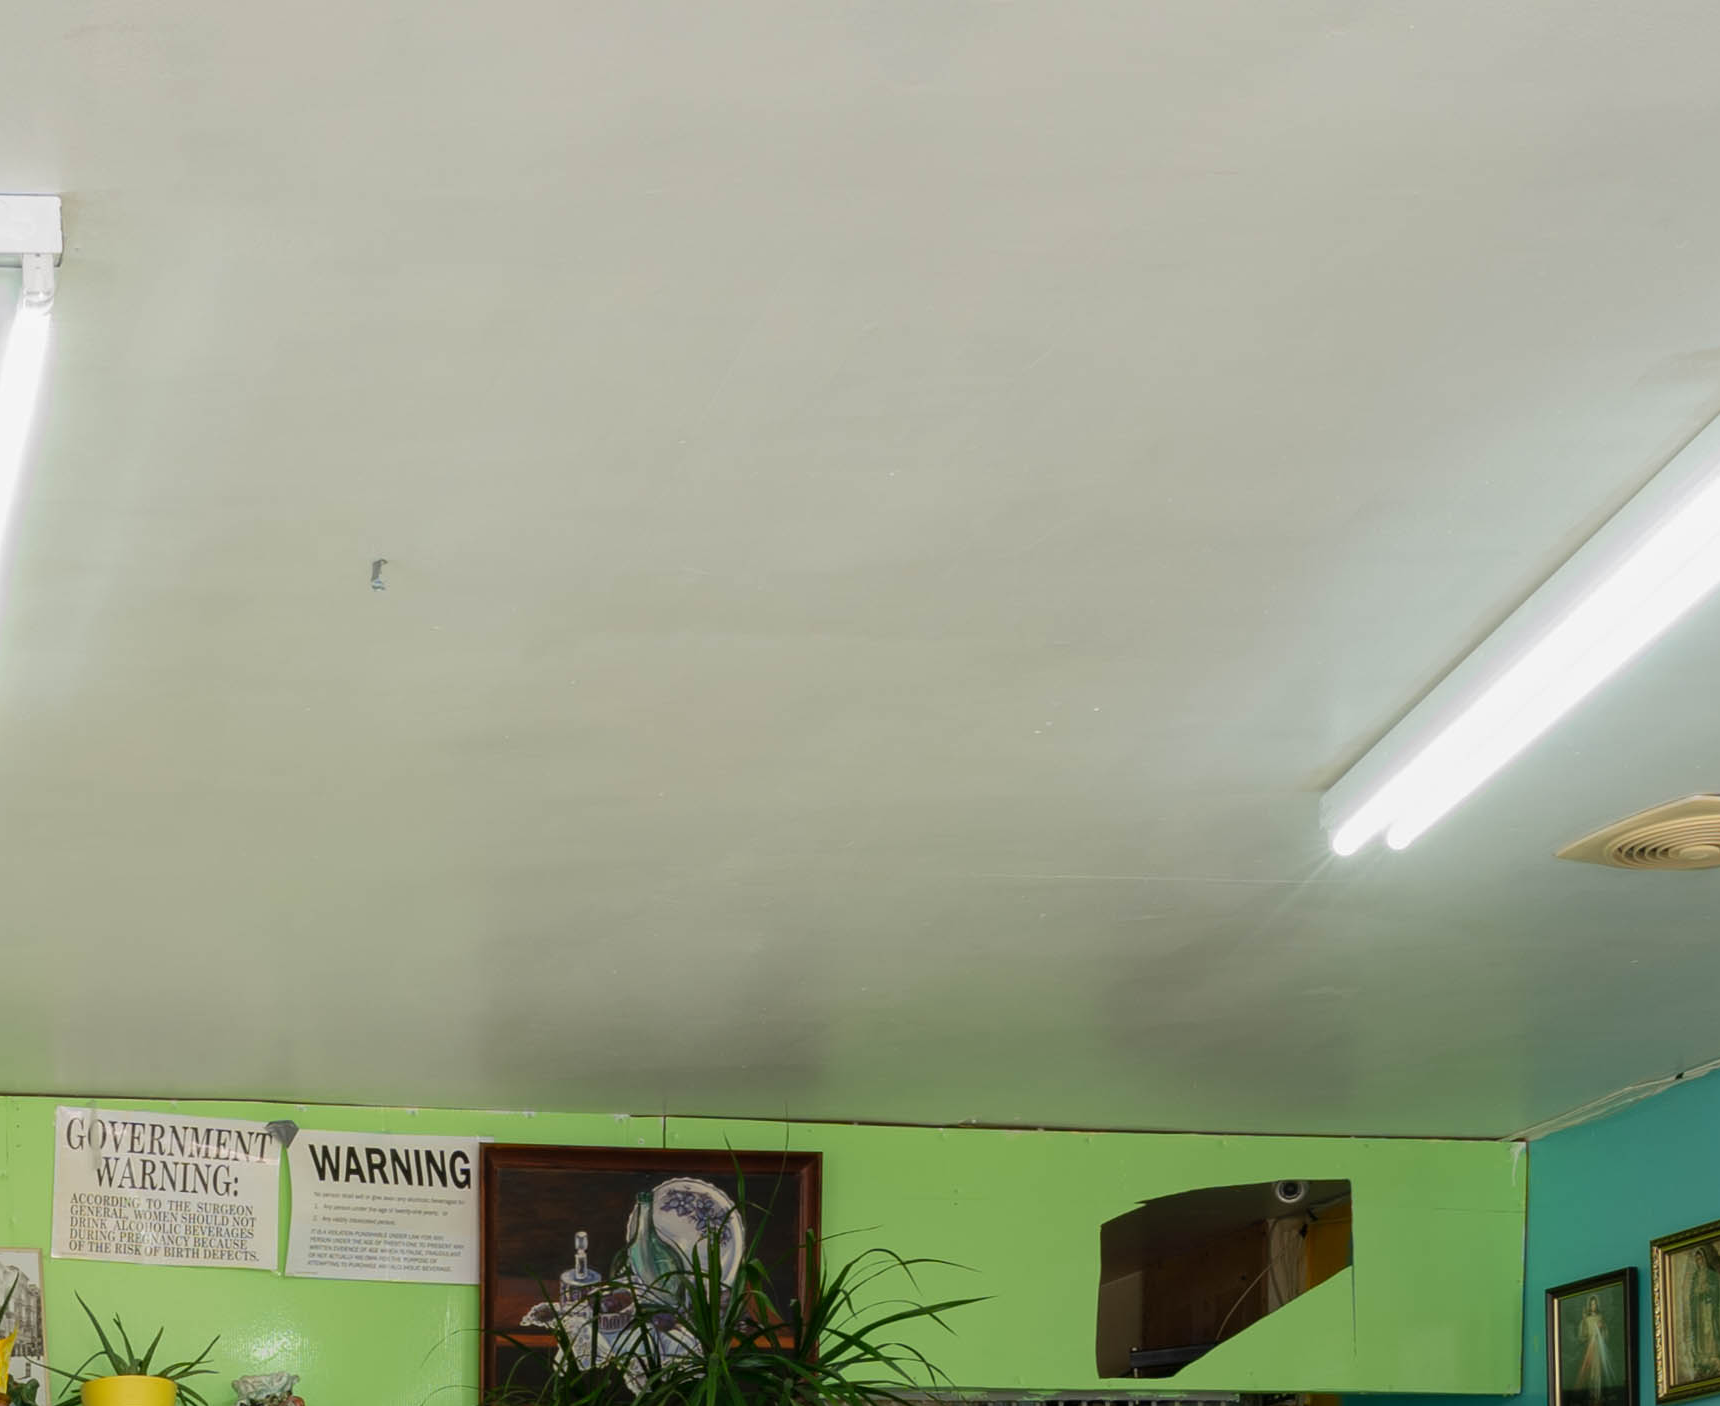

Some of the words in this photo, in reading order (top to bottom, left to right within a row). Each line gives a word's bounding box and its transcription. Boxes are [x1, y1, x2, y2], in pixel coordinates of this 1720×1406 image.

[66, 1117, 273, 1163] GOVERNMENT
[96, 1157, 239, 1197] WARNING:
[308, 1143, 471, 1190] WARNING
[70, 1193, 140, 1208] ACCORDING
[146, 1199, 162, 1210] TO
[167, 1200, 191, 1213] THE
[197, 1202, 254, 1216] SURGEON
[70, 1205, 129, 1220] GENERAL,
[134, 1209, 178, 1222] WOMEN
[181, 1212, 229, 1226] SHOULD
[232, 1216, 257, 1228] NOT
[70, 1217, 108, 1229] DRINK
[115, 1220, 181, 1234] ALCOHOLIC
[185, 1224, 254, 1239] BEVERAGES
[69, 1240, 85, 1251] OF
[87, 1242, 111, 1253] THE
[115, 1243, 141, 1256] RISK
[144, 1245, 160, 1256] OF
[164, 1247, 202, 1259] BIRTH
[206, 1249, 260, 1261] DEFECTS.
[70, 1228, 116, 1242] DURING
[120, 1231, 189, 1248] PREGNANCY
[193, 1236, 248, 1250] BECAUSE
